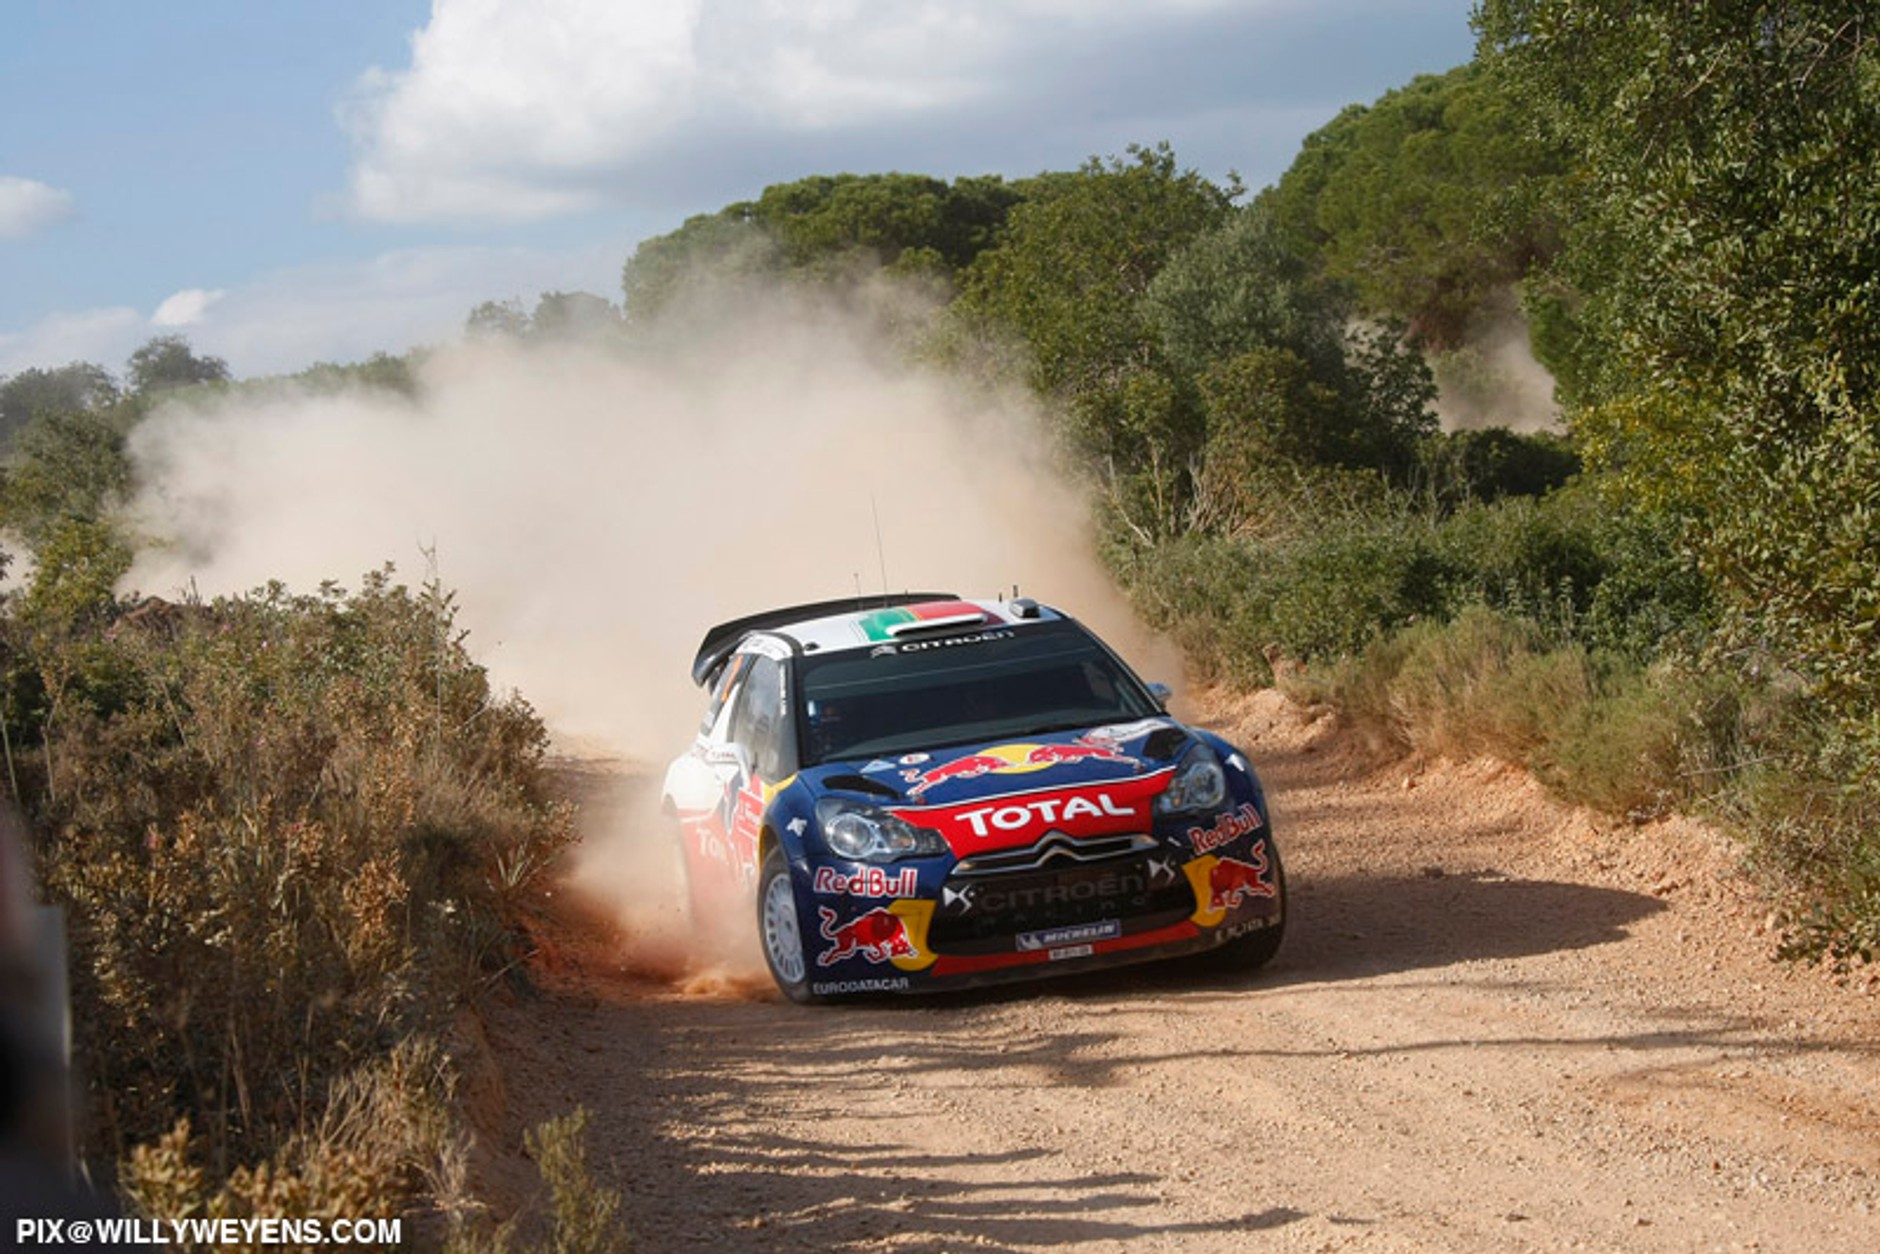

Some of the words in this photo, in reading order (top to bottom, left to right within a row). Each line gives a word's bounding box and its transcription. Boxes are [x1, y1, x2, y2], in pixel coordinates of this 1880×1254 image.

[955, 794, 1135, 836] TOTAL
[1043, 923, 1115, 943] MICHELIN
[812, 977, 910, 995] EURODATACAR
